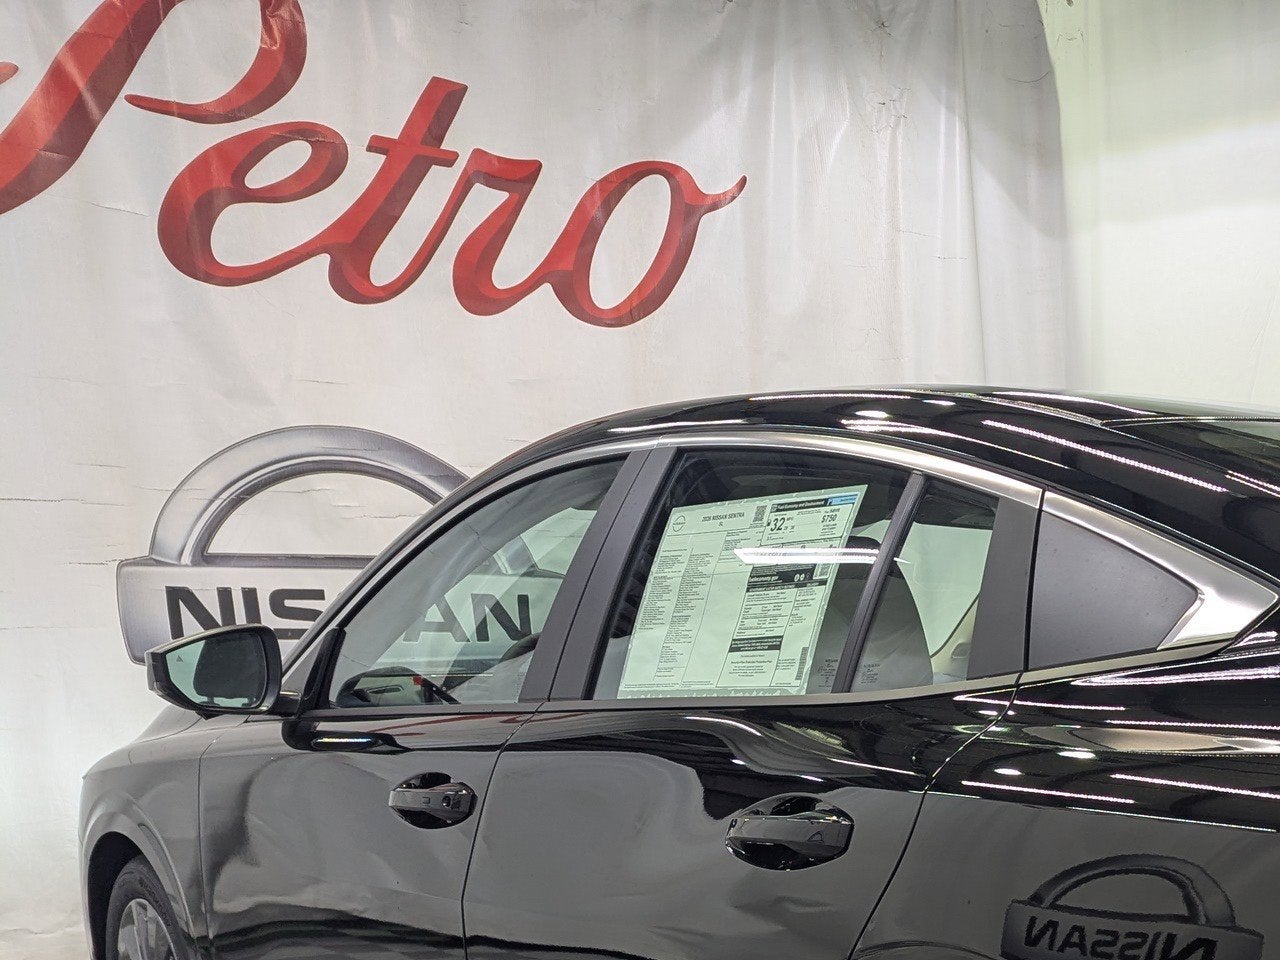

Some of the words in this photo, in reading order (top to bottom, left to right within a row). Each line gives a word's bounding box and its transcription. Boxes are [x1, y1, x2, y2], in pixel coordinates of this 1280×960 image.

[770, 517, 785, 532] 32
[821, 514, 837, 523] $750
[164, 585, 532, 642] NISAN
